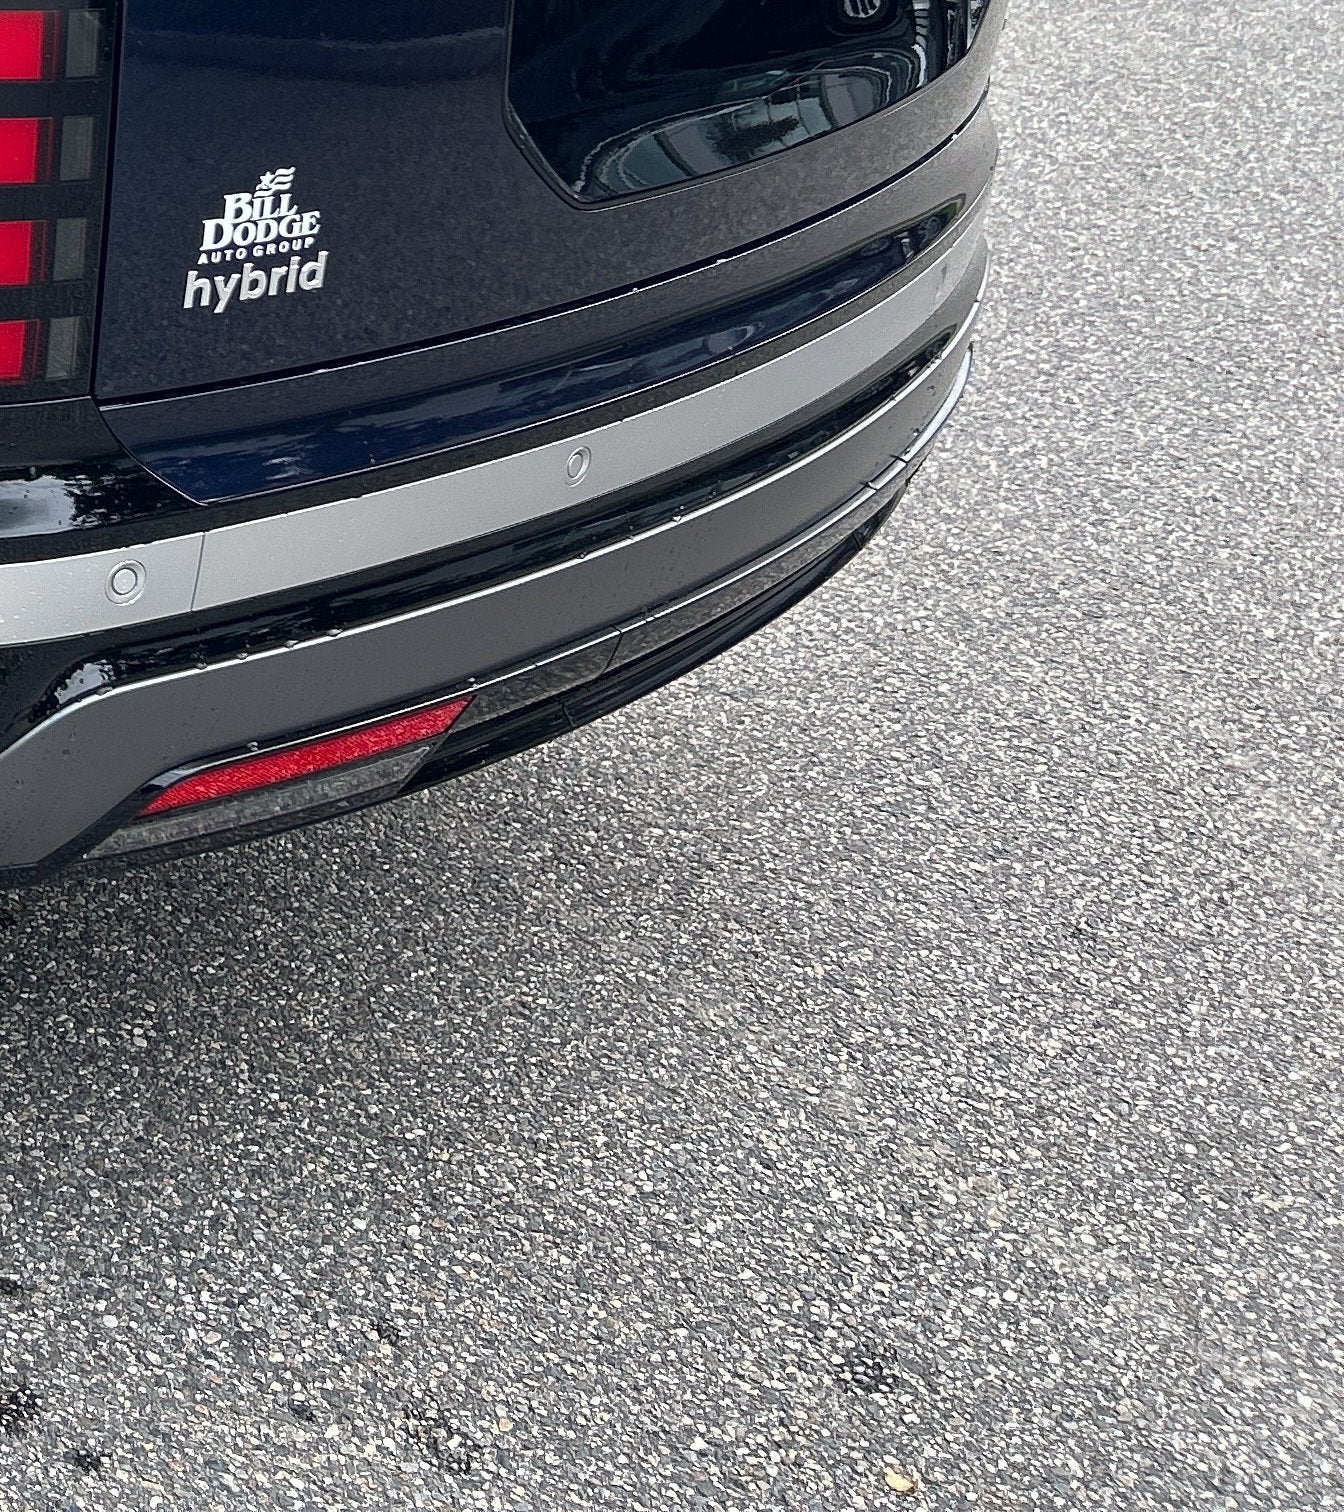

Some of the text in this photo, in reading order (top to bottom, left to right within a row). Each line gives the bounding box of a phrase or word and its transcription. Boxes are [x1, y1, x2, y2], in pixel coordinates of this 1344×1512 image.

[222, 192, 299, 224] BILL
[198, 209, 322, 251] DODGE
[197, 237, 315, 265] AUTO GROUP
[182, 250, 330, 314] hybrid
